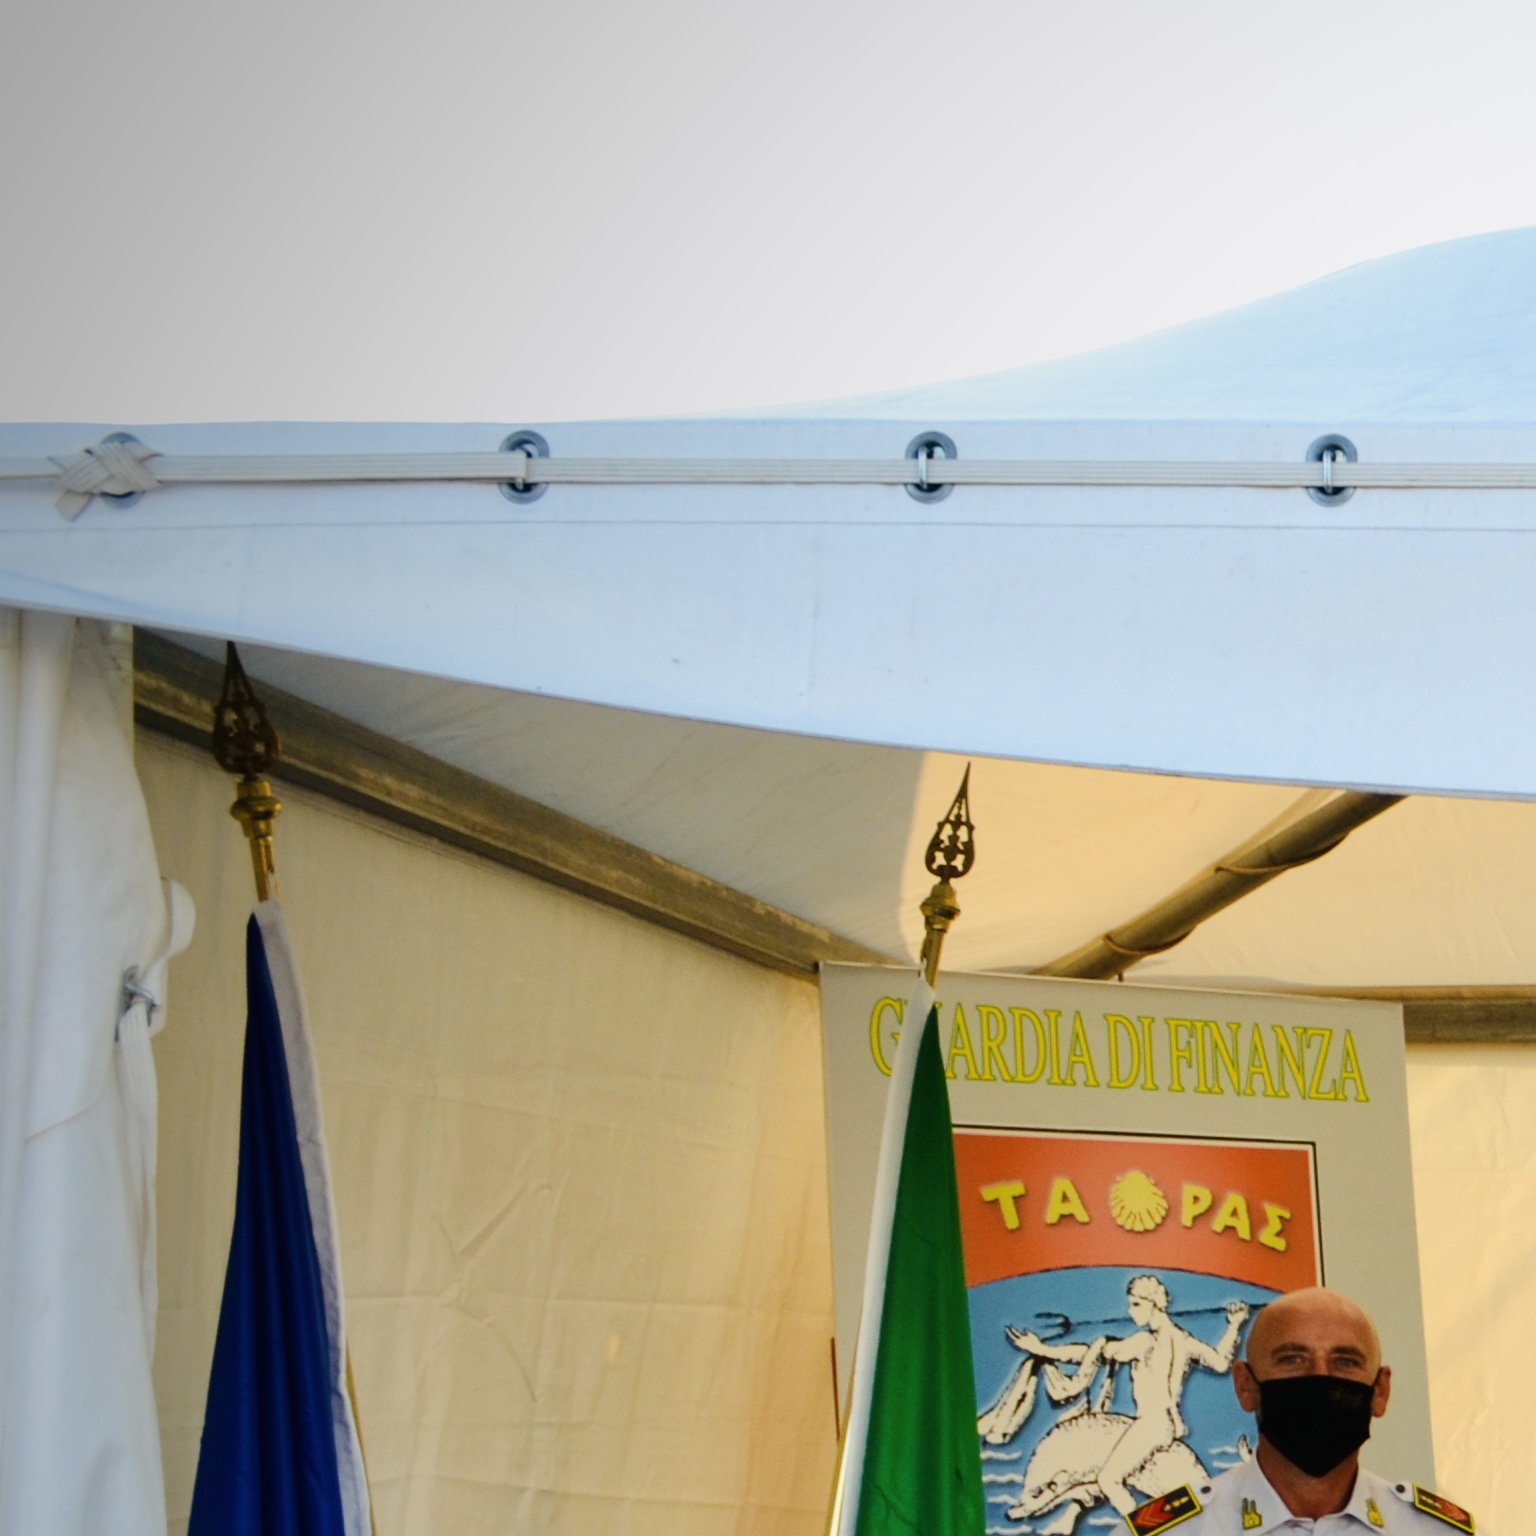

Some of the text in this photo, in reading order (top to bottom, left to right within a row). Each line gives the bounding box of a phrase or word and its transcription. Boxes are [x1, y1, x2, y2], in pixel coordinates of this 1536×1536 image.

[869, 996, 1371, 1103] GARDIA DI FINANZA
